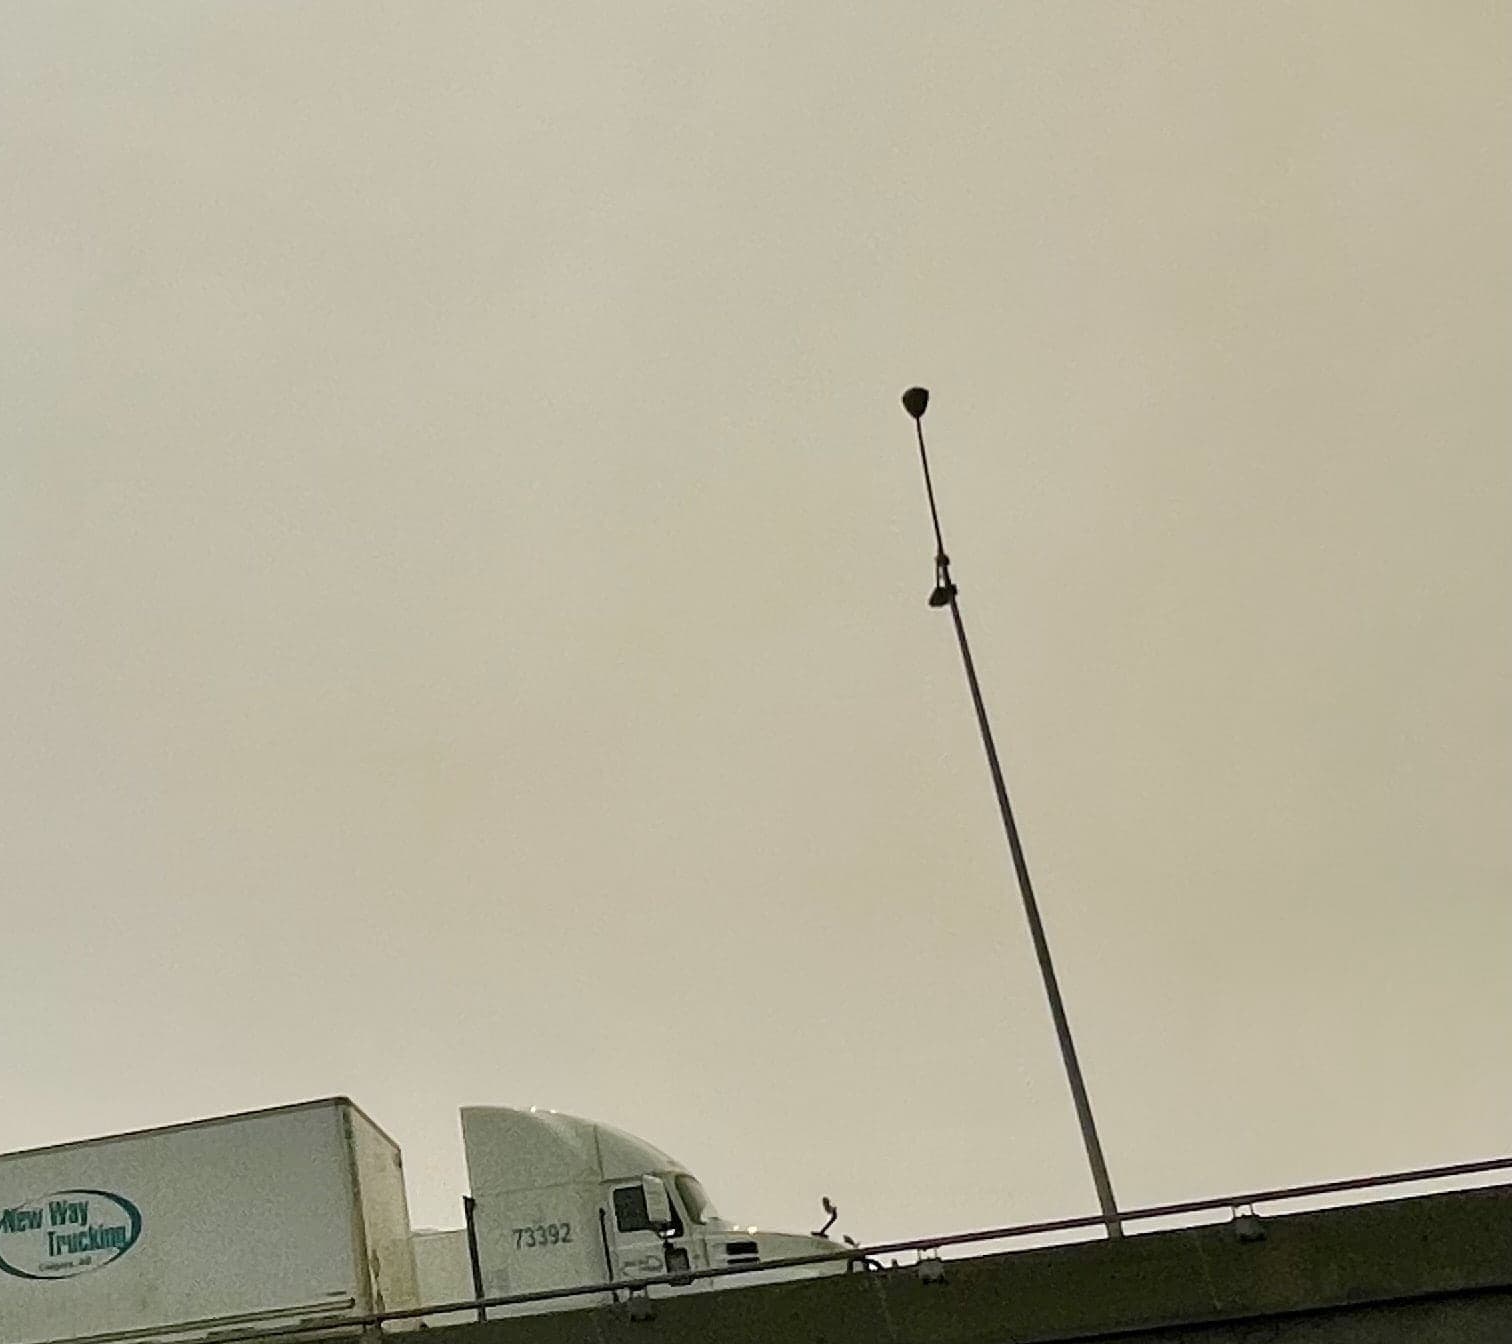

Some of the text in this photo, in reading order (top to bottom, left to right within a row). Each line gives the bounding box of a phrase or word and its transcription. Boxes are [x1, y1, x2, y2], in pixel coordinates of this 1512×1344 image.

[0, 1199, 90, 1234] New Way
[47, 1222, 127, 1257] Trucking
[511, 1222, 574, 1250] 73392
